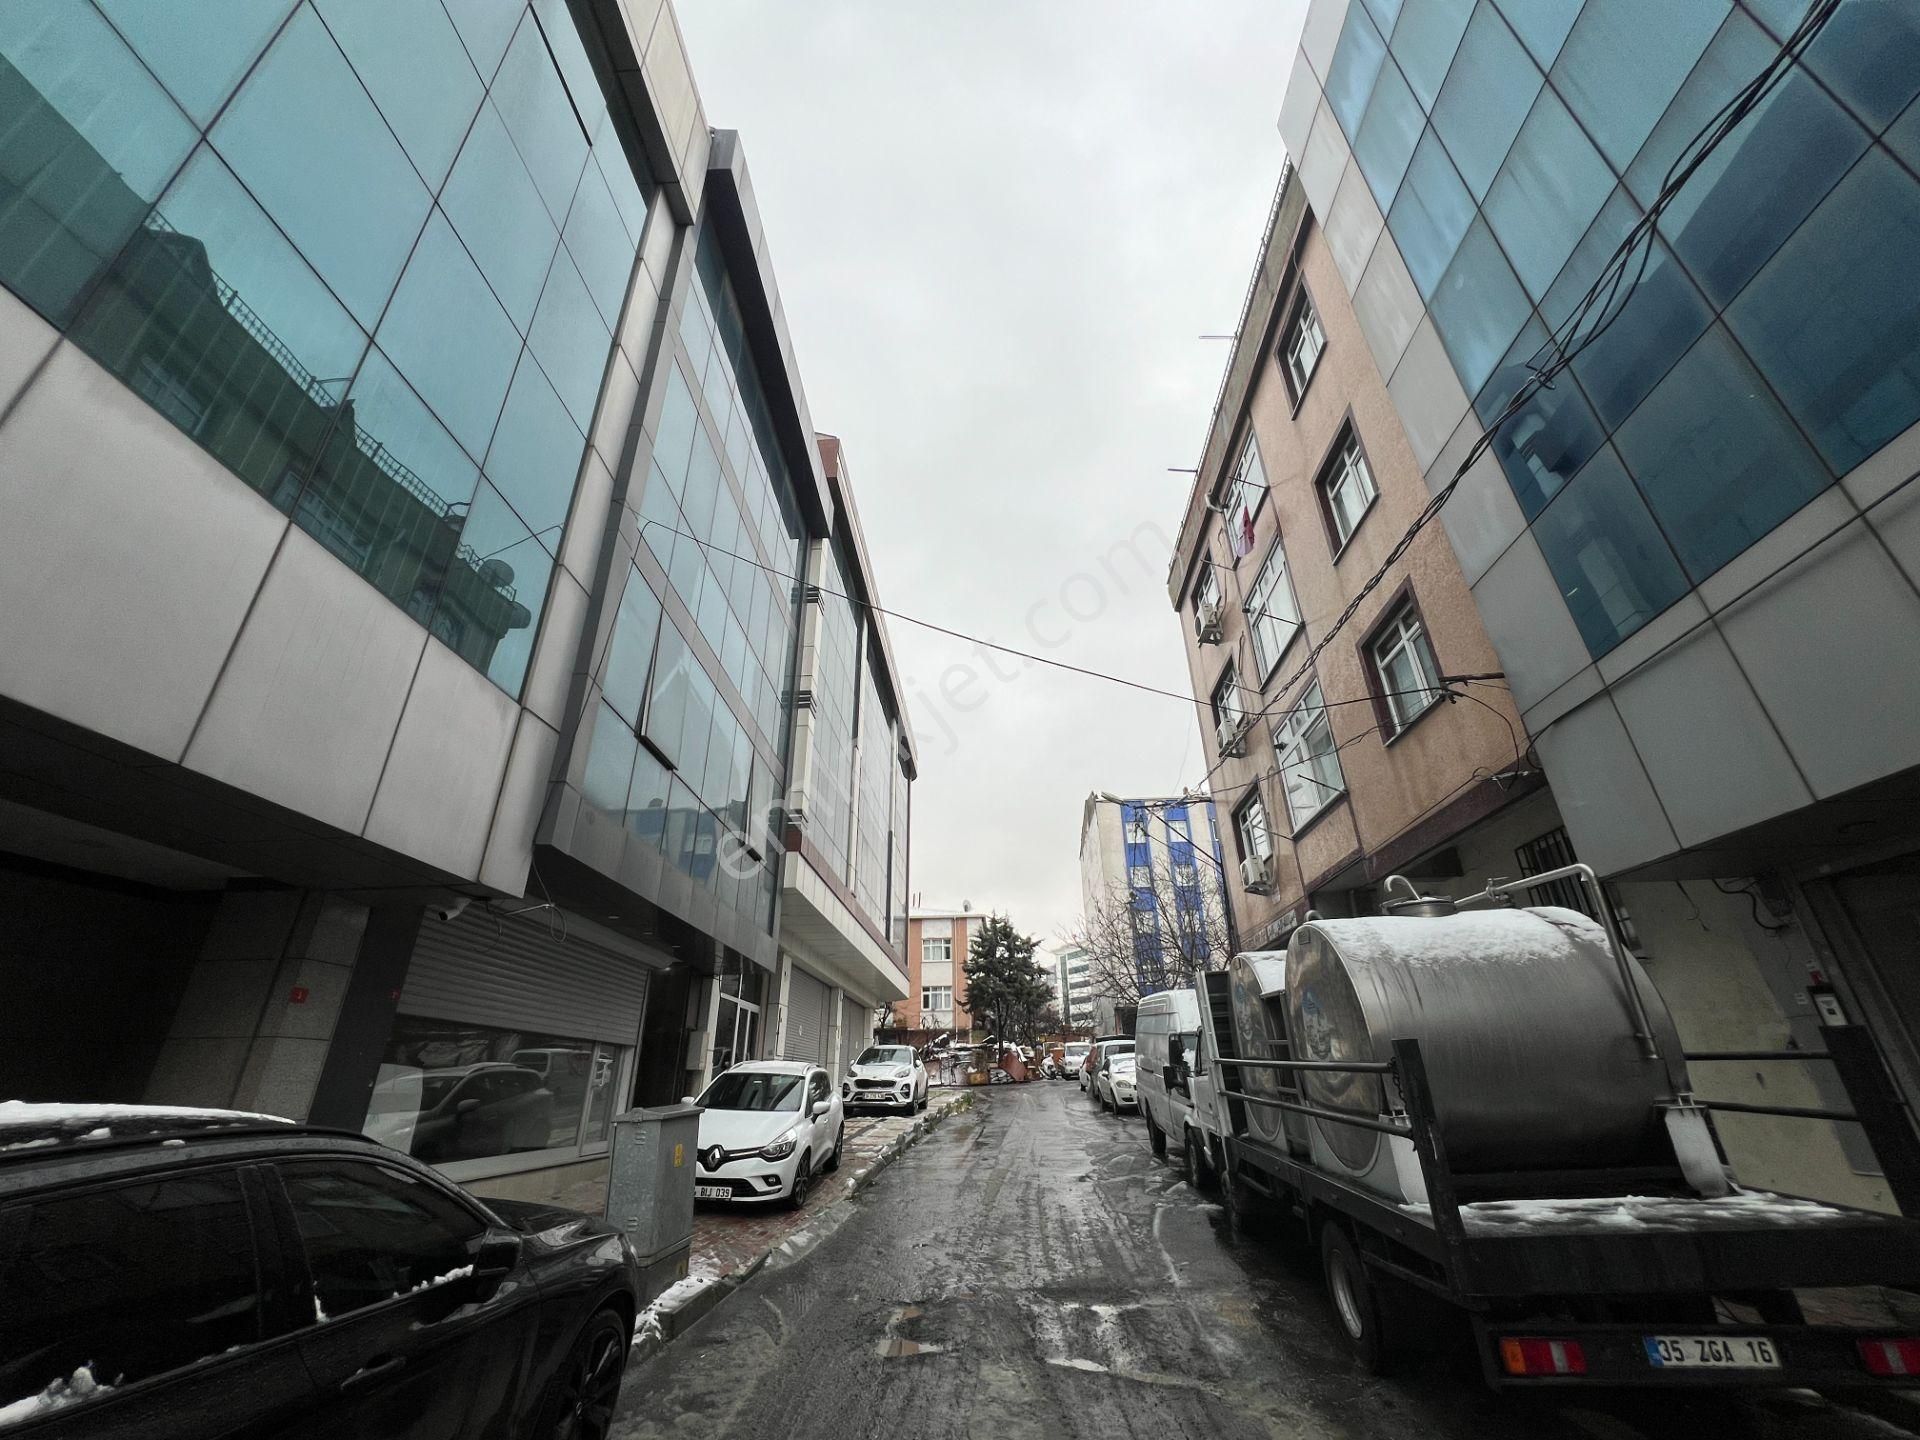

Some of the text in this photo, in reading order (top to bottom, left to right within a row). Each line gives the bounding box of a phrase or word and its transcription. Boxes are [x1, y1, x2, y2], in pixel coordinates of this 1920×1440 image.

[700, 1187, 712, 1197] BIJ
[715, 1187, 730, 1198] 039
[1657, 1340, 1686, 1362] 35
[1694, 1340, 1736, 1363] ZGA
[1746, 1341, 1774, 1364] 16
